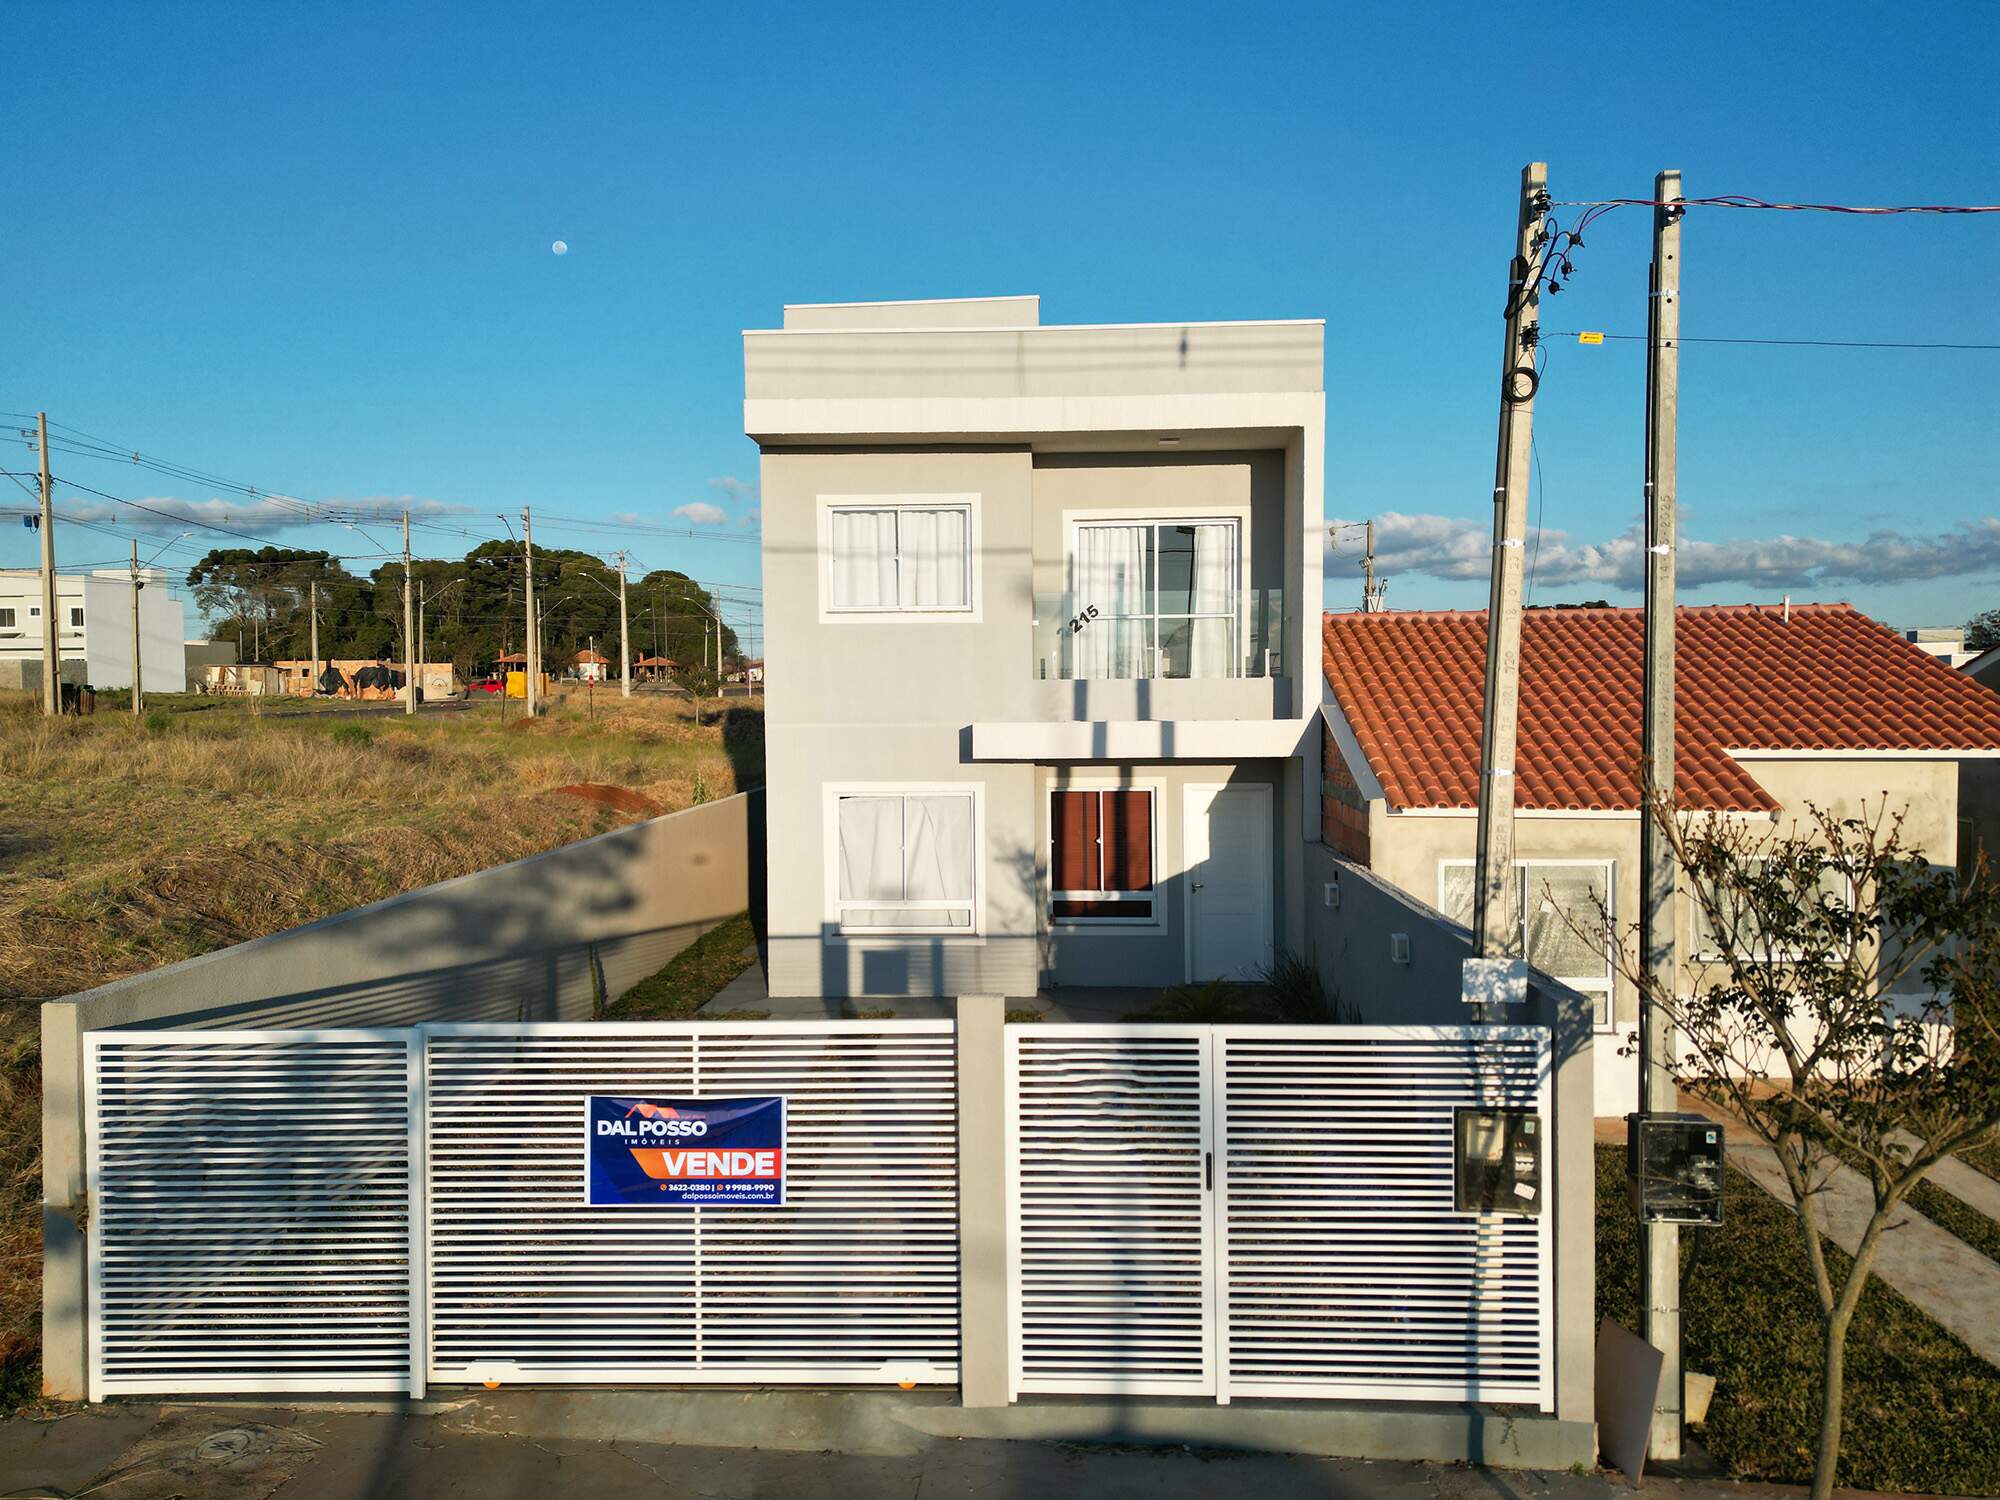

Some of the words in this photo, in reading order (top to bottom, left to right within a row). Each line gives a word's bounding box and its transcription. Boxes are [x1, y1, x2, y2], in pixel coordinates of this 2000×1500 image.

[1068, 604, 1099, 633] 215
[597, 1120, 637, 1136] DAL
[639, 1120, 708, 1136] POSSO
[661, 1151, 775, 1176] VENDE
[682, 1192, 775, 1200] dalpossoimoveis.com.br
